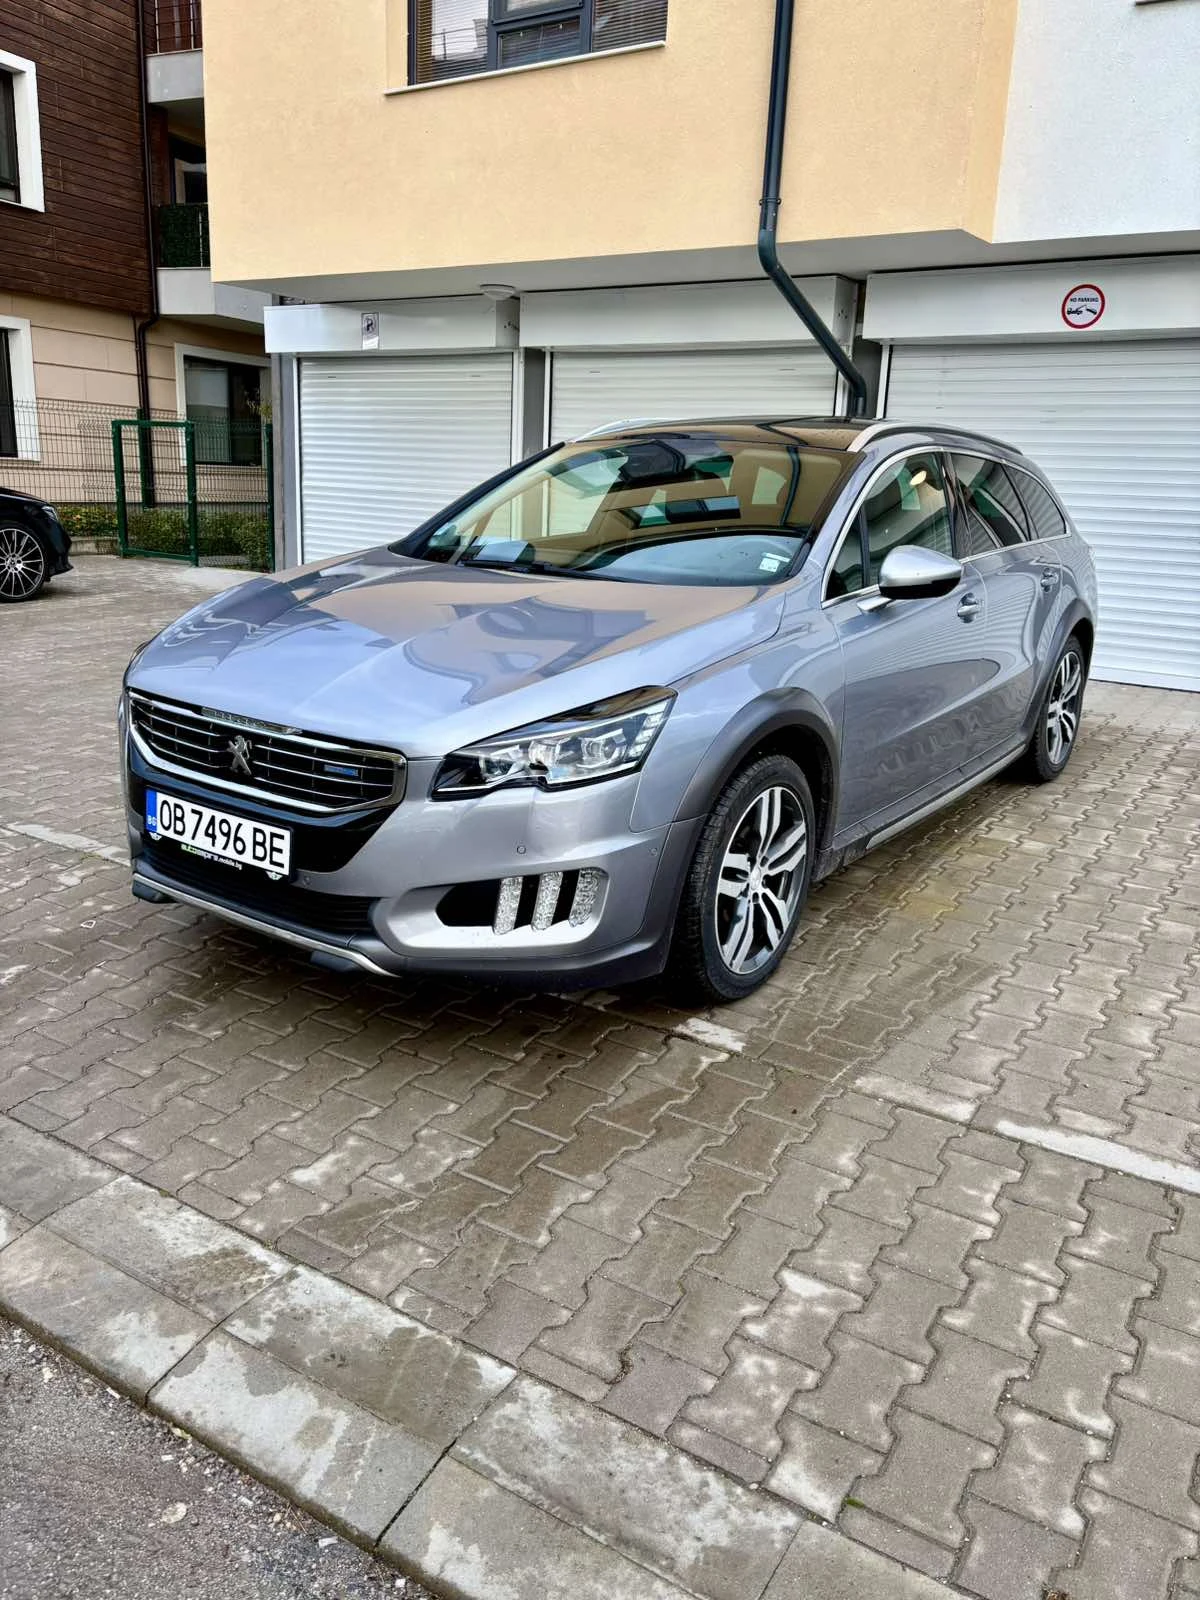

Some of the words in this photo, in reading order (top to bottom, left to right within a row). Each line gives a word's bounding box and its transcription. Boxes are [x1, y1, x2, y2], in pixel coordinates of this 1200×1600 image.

[147, 814, 157, 826] BG
[160, 800, 186, 836] OB
[190, 808, 247, 856] 7496
[252, 827, 285, 868] BE
